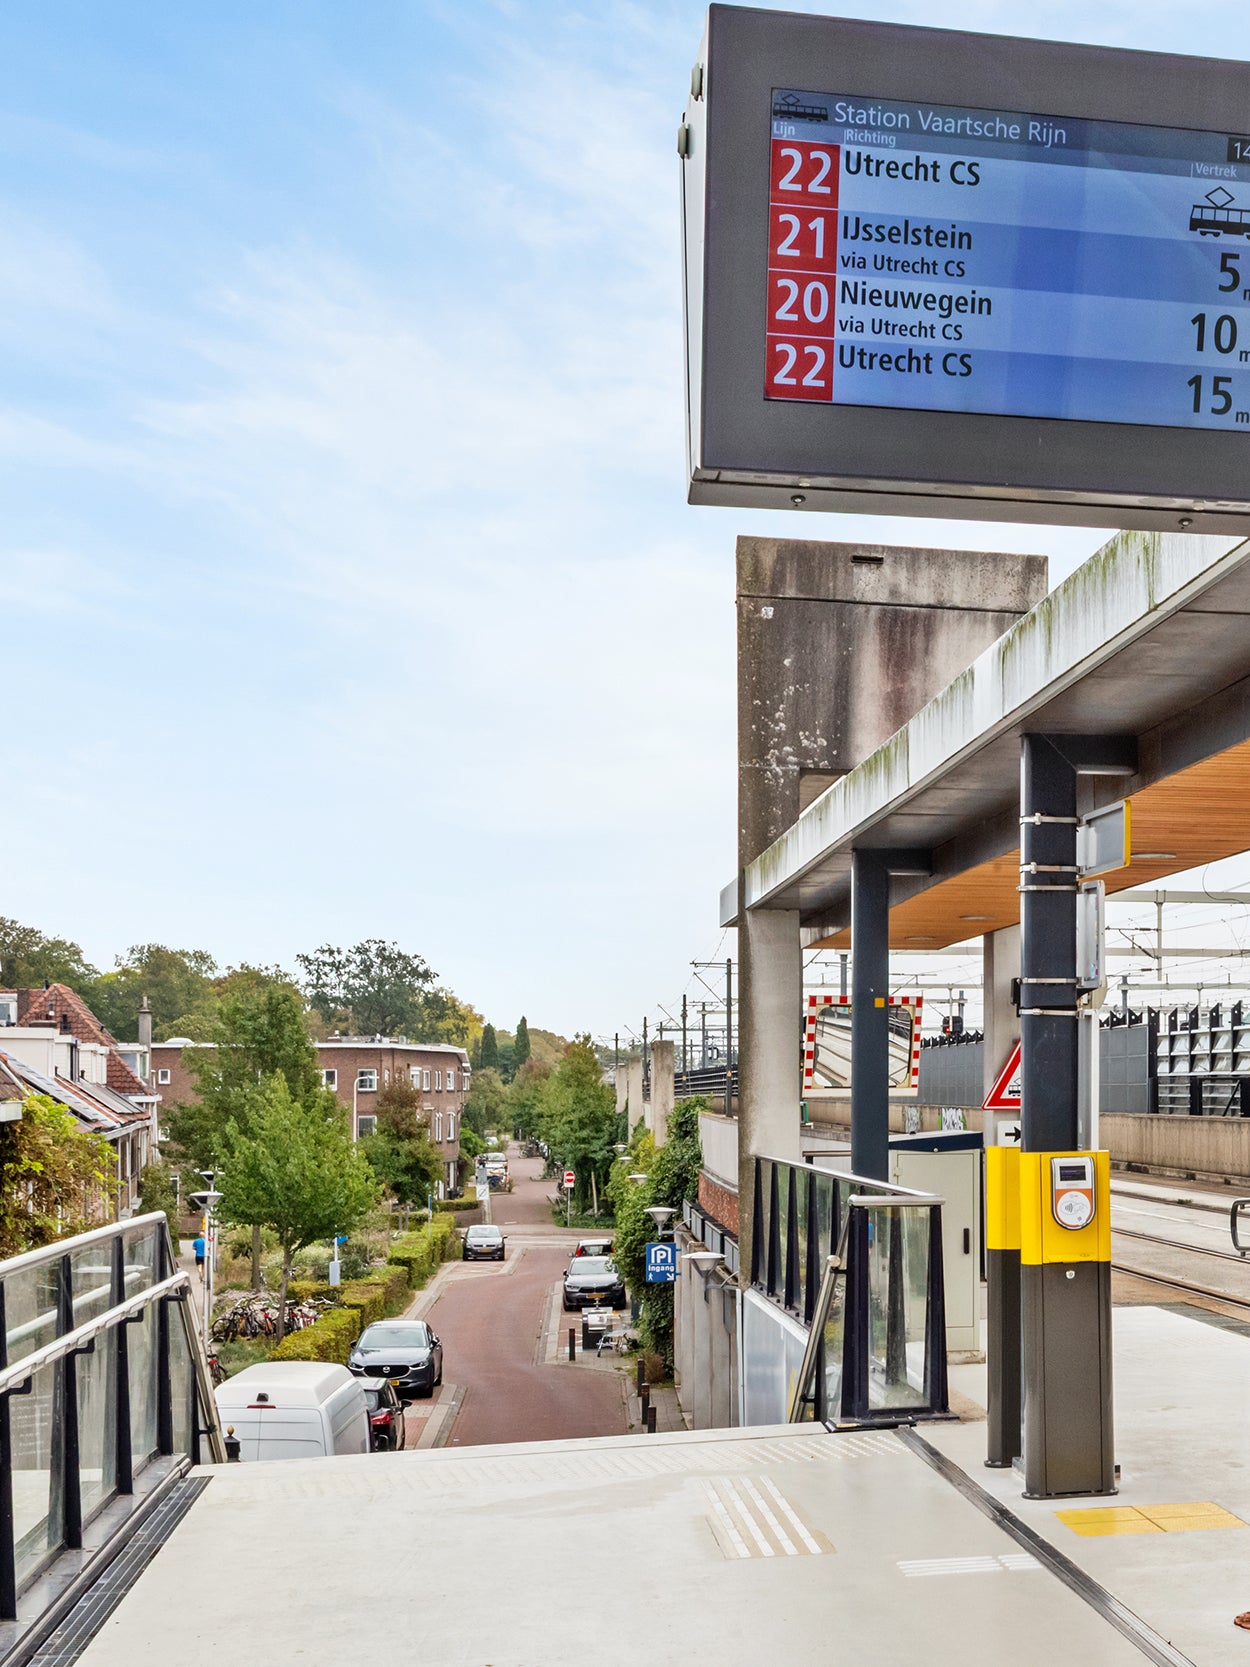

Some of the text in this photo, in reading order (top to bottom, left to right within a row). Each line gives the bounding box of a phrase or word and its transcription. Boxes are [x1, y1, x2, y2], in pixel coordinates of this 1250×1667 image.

[773, 122, 795, 138] Lijn
[834, 102, 1066, 148] Station Vaartsche Rijn
[846, 129, 896, 148] Richting
[778, 148, 832, 194] 22
[845, 150, 980, 186] Utrecht CS
[1195, 163, 1237, 178] Vertrek
[776, 213, 825, 259] 21
[843, 215, 972, 250] IJsselstein
[841, 252, 965, 277] via Utrecht CS
[1218, 252, 1240, 292] 5
[775, 278, 829, 324] 20
[841, 280, 992, 319] Nieuwegein
[839, 316, 963, 341] via Utrecht CS
[1191, 312, 1237, 354] 10
[773, 343, 826, 388] 22
[838, 345, 972, 377] Utrecht CS
[1187, 374, 1232, 415] 15
[656, 1250, 666, 1263] P
